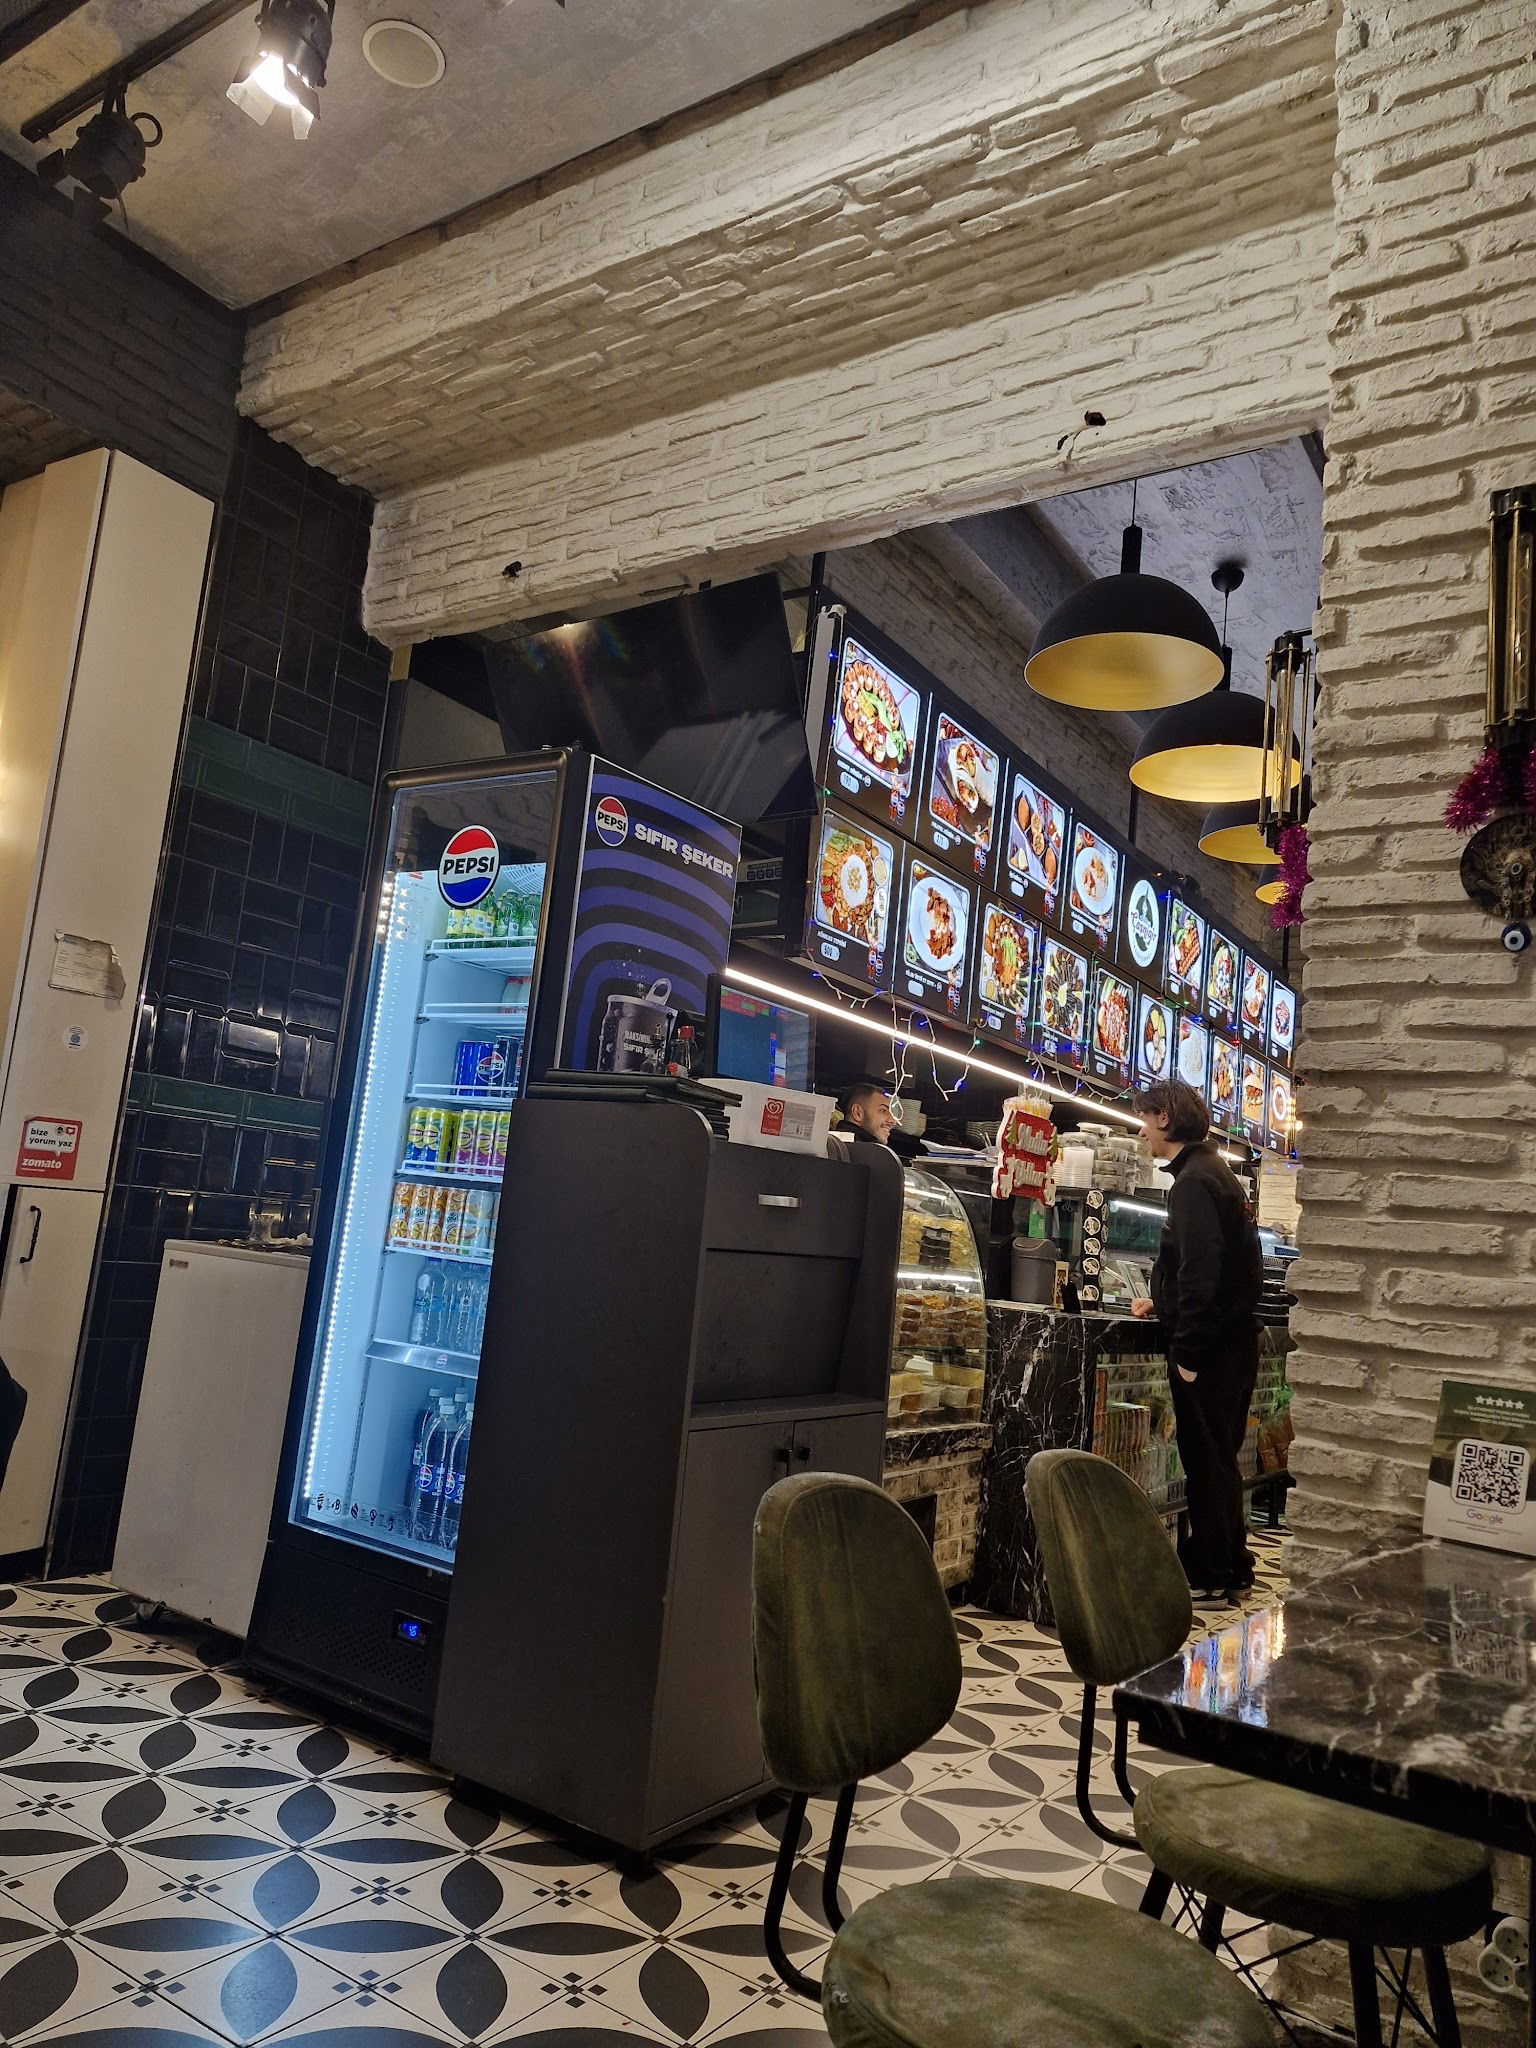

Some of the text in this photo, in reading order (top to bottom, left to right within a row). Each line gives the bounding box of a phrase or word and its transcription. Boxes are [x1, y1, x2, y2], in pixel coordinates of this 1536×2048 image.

[597, 811, 626, 832] PEPSI
[634, 823, 733, 879] SIFIR ŞEKER
[443, 856, 495, 875] PEPSI
[30, 1128, 48, 1136] bize
[29, 1137, 56, 1145] yorum
[21, 1158, 61, 1168] zomato
[1466, 1508, 1504, 1525] Google
